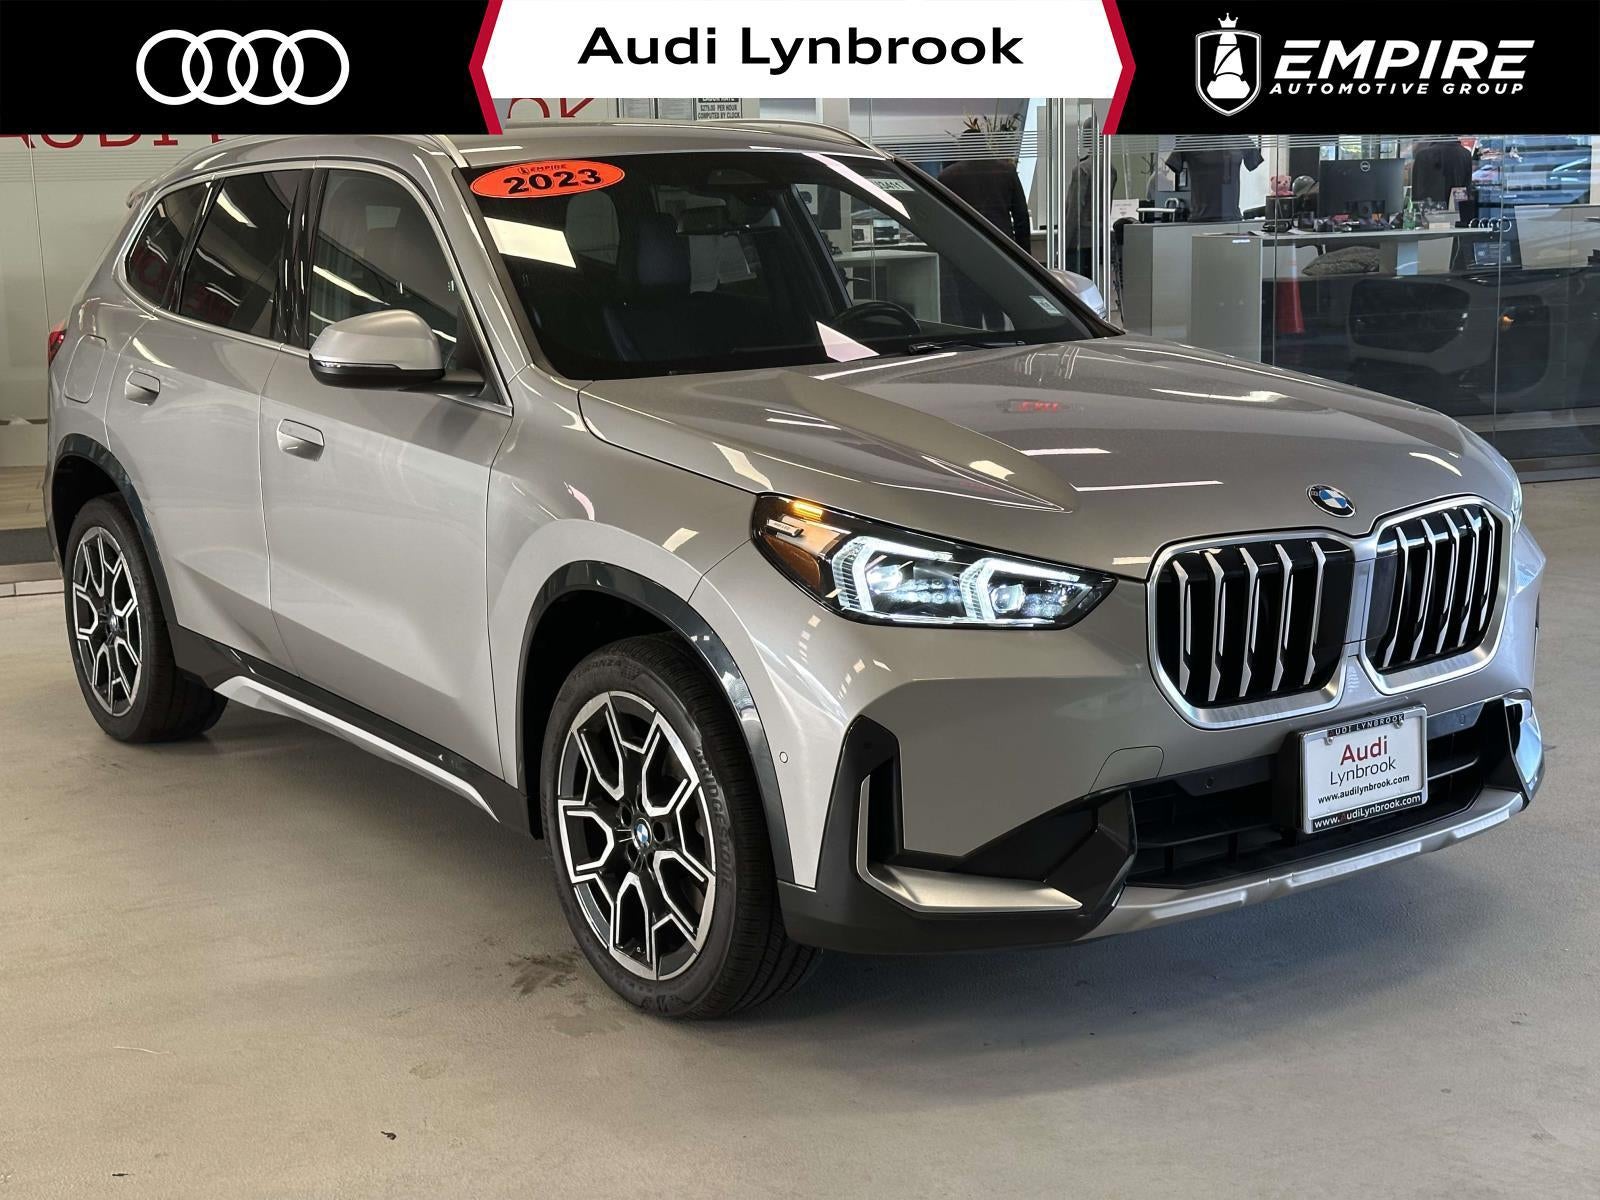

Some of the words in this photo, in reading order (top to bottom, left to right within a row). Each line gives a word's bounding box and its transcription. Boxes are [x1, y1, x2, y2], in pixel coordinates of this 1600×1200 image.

[503, 168, 602, 194] 2023
[530, 164, 567, 172] EMPIRE
[1356, 714, 1403, 731] LYNBROOK
[1340, 735, 1388, 766] Audi
[1330, 756, 1397, 786] Lynbrook
[1317, 774, 1410, 805] www.audilynbrook.com
[1314, 795, 1421, 828] www.AudiLynbrook.com
